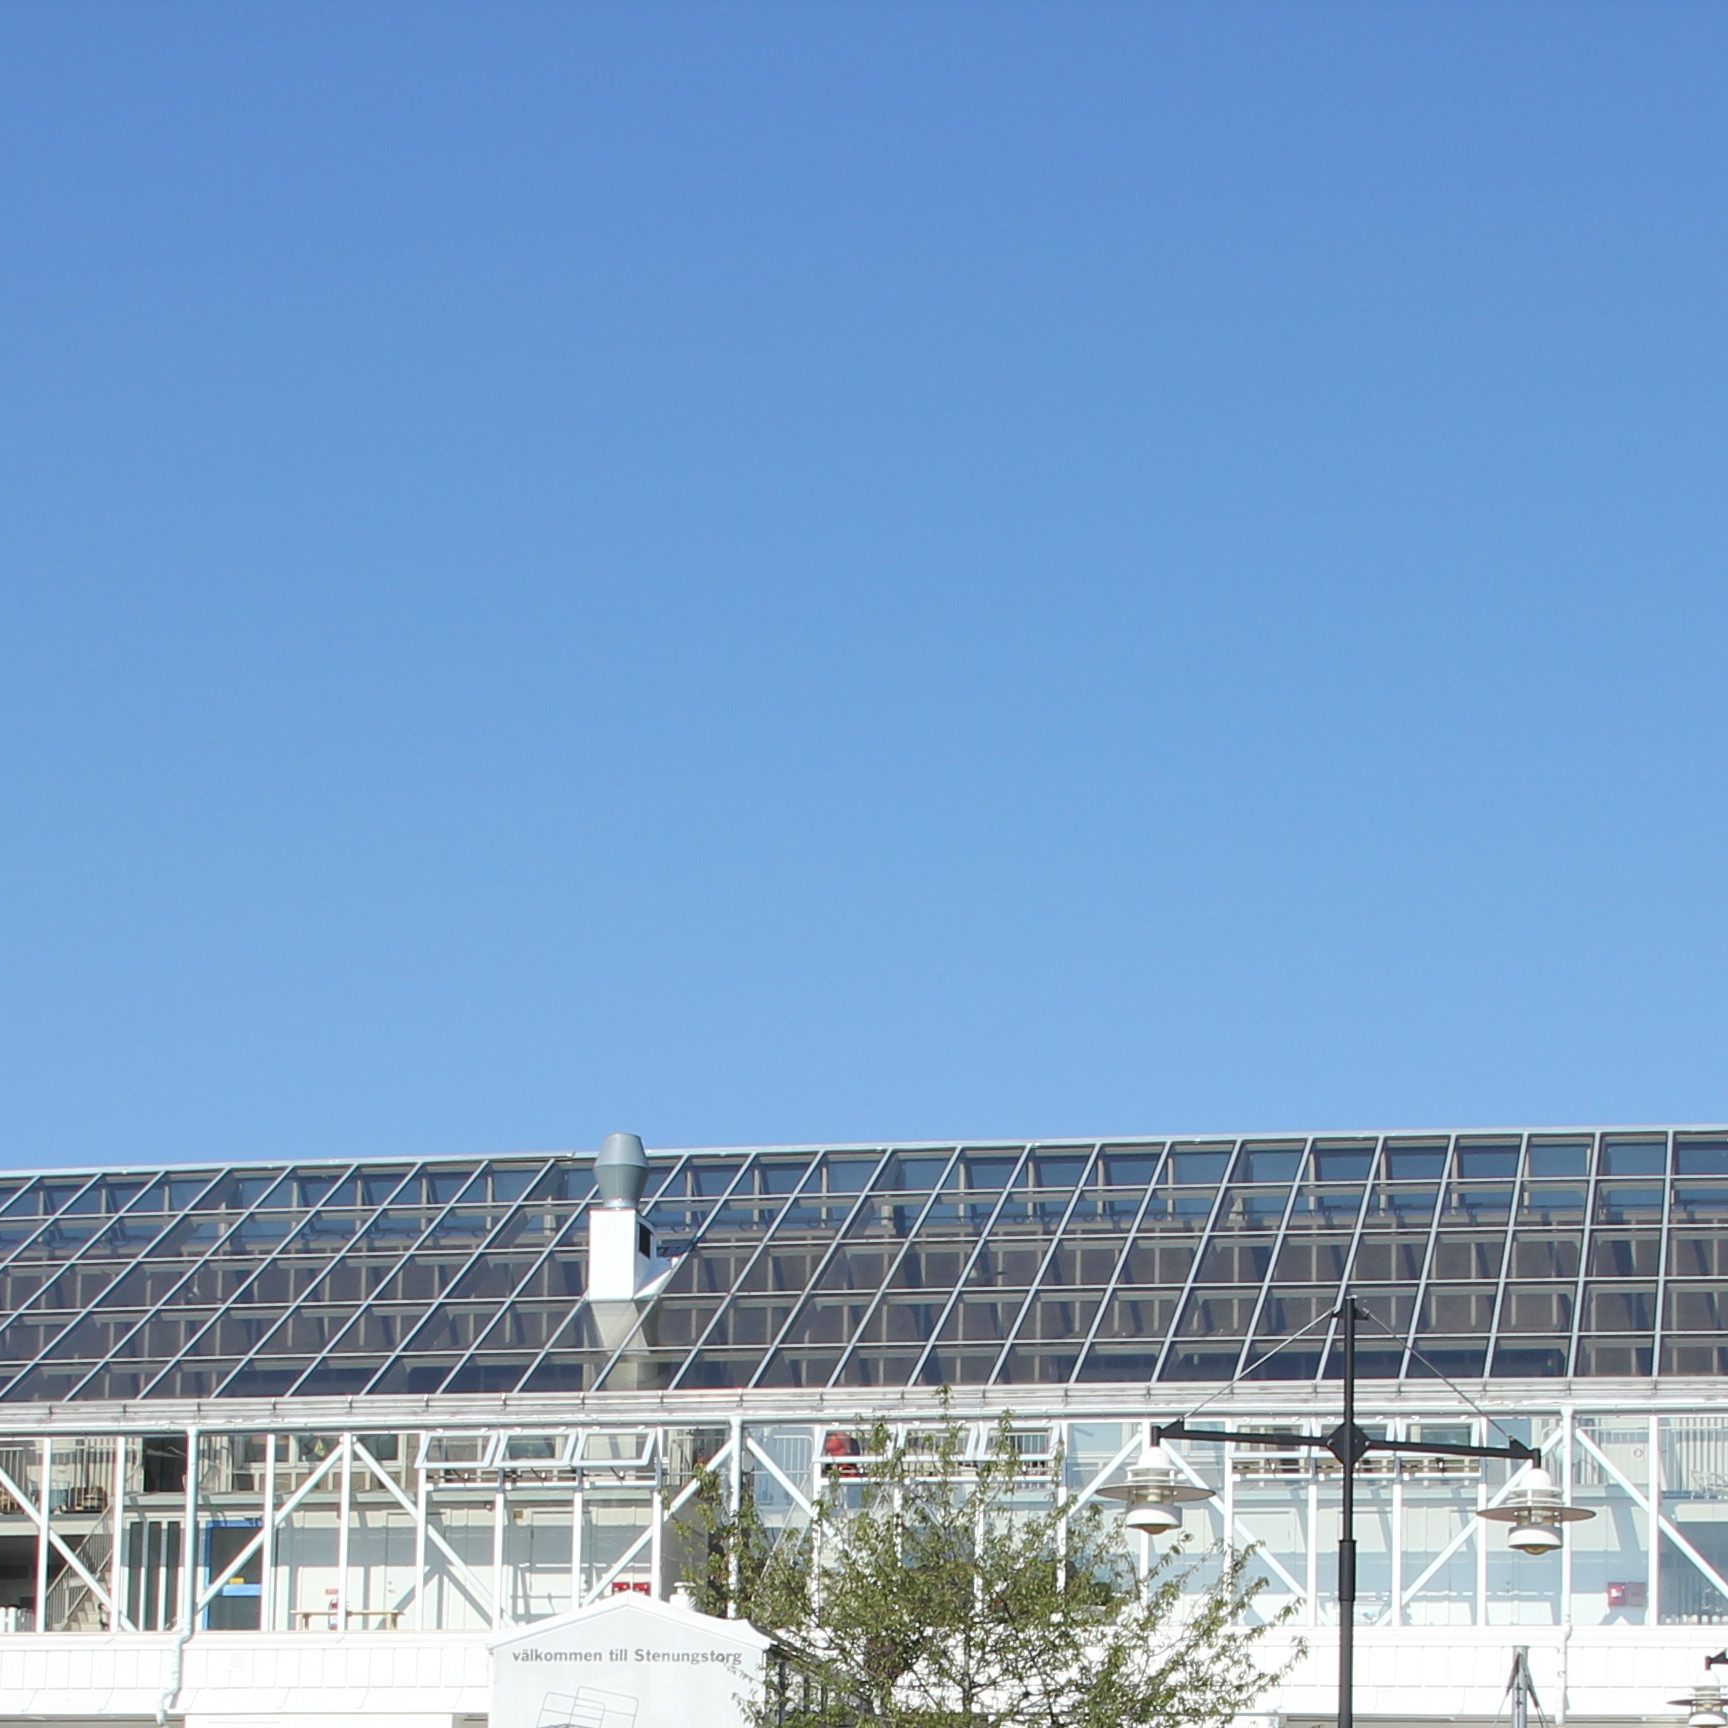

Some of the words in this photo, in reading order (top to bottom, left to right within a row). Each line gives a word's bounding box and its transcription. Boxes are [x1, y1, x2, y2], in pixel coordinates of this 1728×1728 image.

[512, 1648, 602, 1662] välkommen
[609, 1648, 628, 1662] till
[634, 1648, 743, 1665] Stenungstorg
